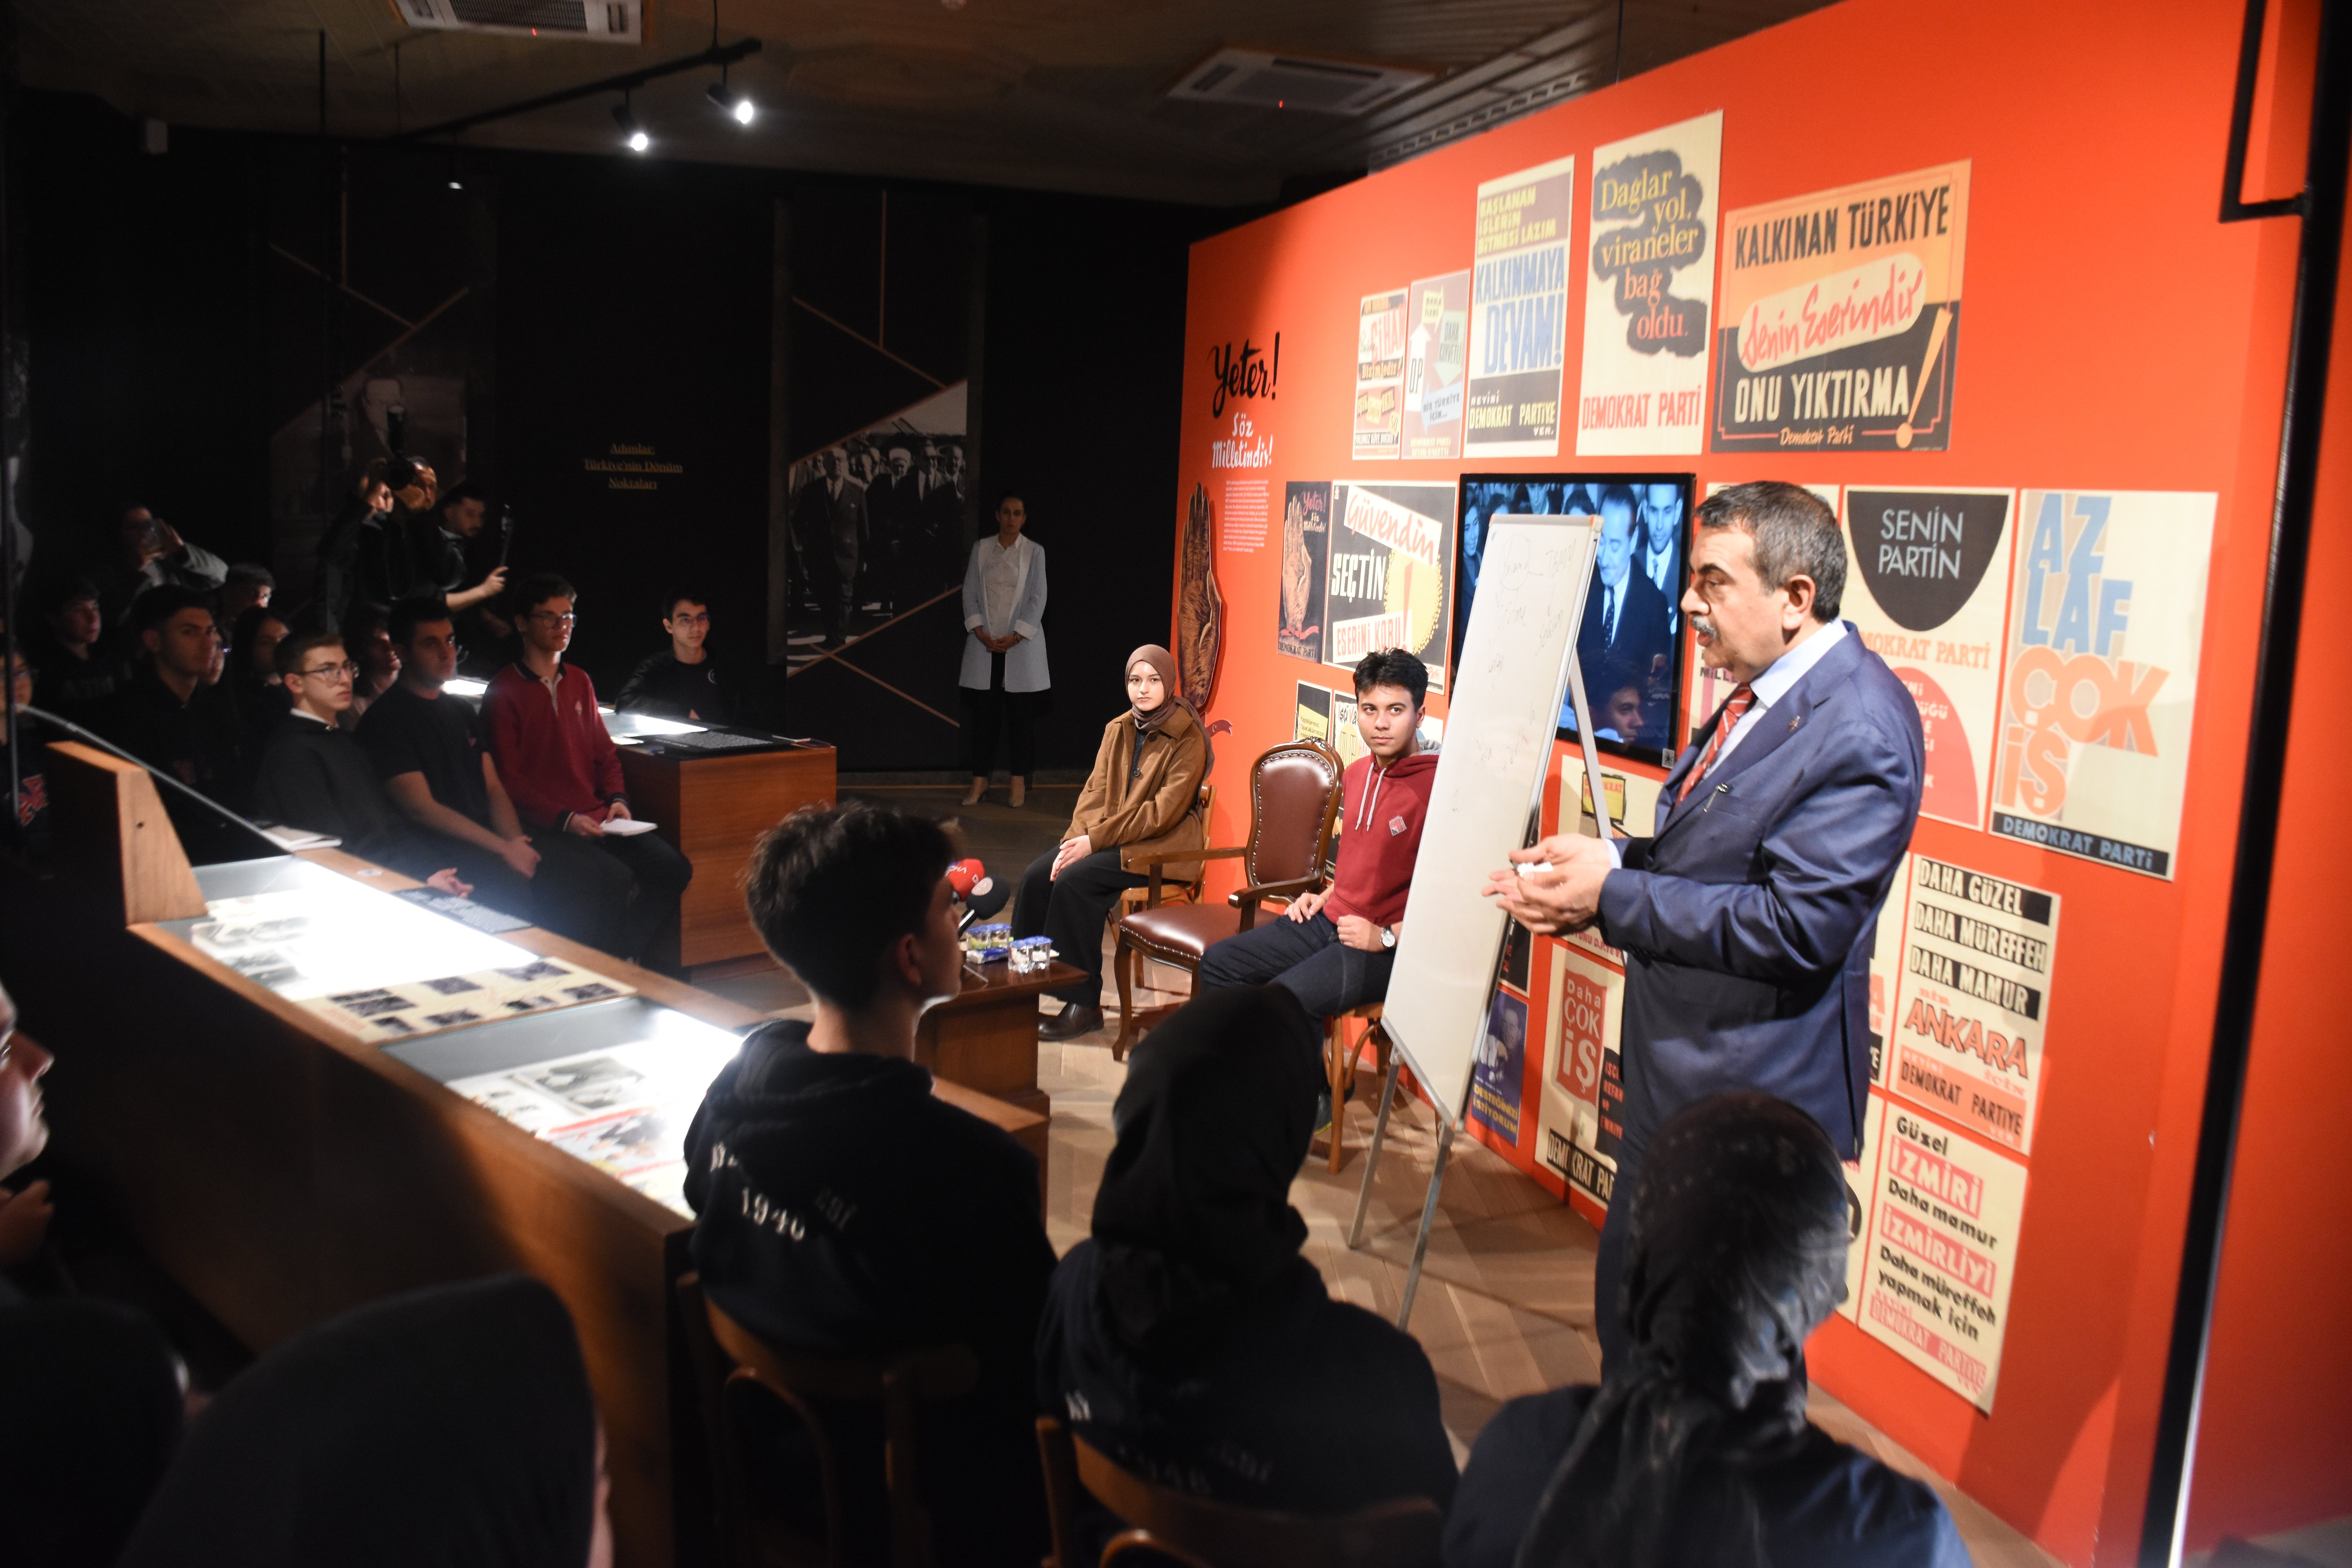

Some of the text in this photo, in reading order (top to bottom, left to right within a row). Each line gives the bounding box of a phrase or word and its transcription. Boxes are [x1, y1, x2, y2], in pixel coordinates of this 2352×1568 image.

[1602, 228, 1699, 269] viraneler
[1735, 186, 1950, 270] KALKINAN TÜRKİYE
[1475, 247, 1565, 305] KALKINMAYA
[1625, 267, 1662, 308] bağ
[1484, 293, 1563, 374] DEVAM!
[1636, 305, 1688, 340] oldu.
[1803, 262, 1924, 350] Eserindir
[1206, 332, 1280, 419] Yeter!
[1734, 374, 1782, 423] ONU
[1232, 412, 1254, 437] Söz
[1469, 402, 1556, 429] DEMOKRAT PARTİYE
[1582, 385, 1701, 430] DEMOKRAT PARTİ
[1827, 424, 1855, 445] Parti
[1212, 434, 1273, 469] Milletindir!
[1347, 494, 1434, 566] Güvendin
[1881, 506, 1963, 543] SENİN
[2029, 493, 2112, 574] AZ
[1331, 549, 1386, 603] SEÇTİN
[1878, 542, 1961, 579] PARTİN
[1337, 622, 1370, 656] ESERİNİ
[2022, 566, 2133, 656] LAF
[1278, 642, 1301, 655] DEMOKRAT
[1936, 641, 1991, 670] PARTİ
[2009, 646, 2170, 757] ÇOK
[2000, 725, 2068, 816] İŞ
[2003, 818, 2152, 868] DEMOKRAT PARTİ
[1919, 860, 2023, 916] DAHA GÜZEL
[1915, 904, 2047, 972] DAHA MÜREFFEH
[1568, 979, 1601, 1009] Daha
[1911, 947, 2028, 1016] DAHA MAMUR
[1564, 997, 1600, 1039] ÇOK
[1904, 997, 2028, 1079] ANKARA
[1563, 1028, 1597, 1094] İŞ
[1901, 1061, 1962, 1105] DEMOKRAT
[1971, 1093, 2022, 1136] PARTİYE
[1548, 1134, 1594, 1188] DEMOKRAT
[1897, 1116, 1948, 1157] Güzel
[1890, 1139, 1980, 1216] İZMİRİ
[1889, 1178, 1998, 1250] Daha mamur
[1883, 1209, 1993, 1295] İZMİRLİYİ
[1878, 1269, 1979, 1342] yapmak için
[1880, 1244, 1996, 1328] Daha müreffeh
